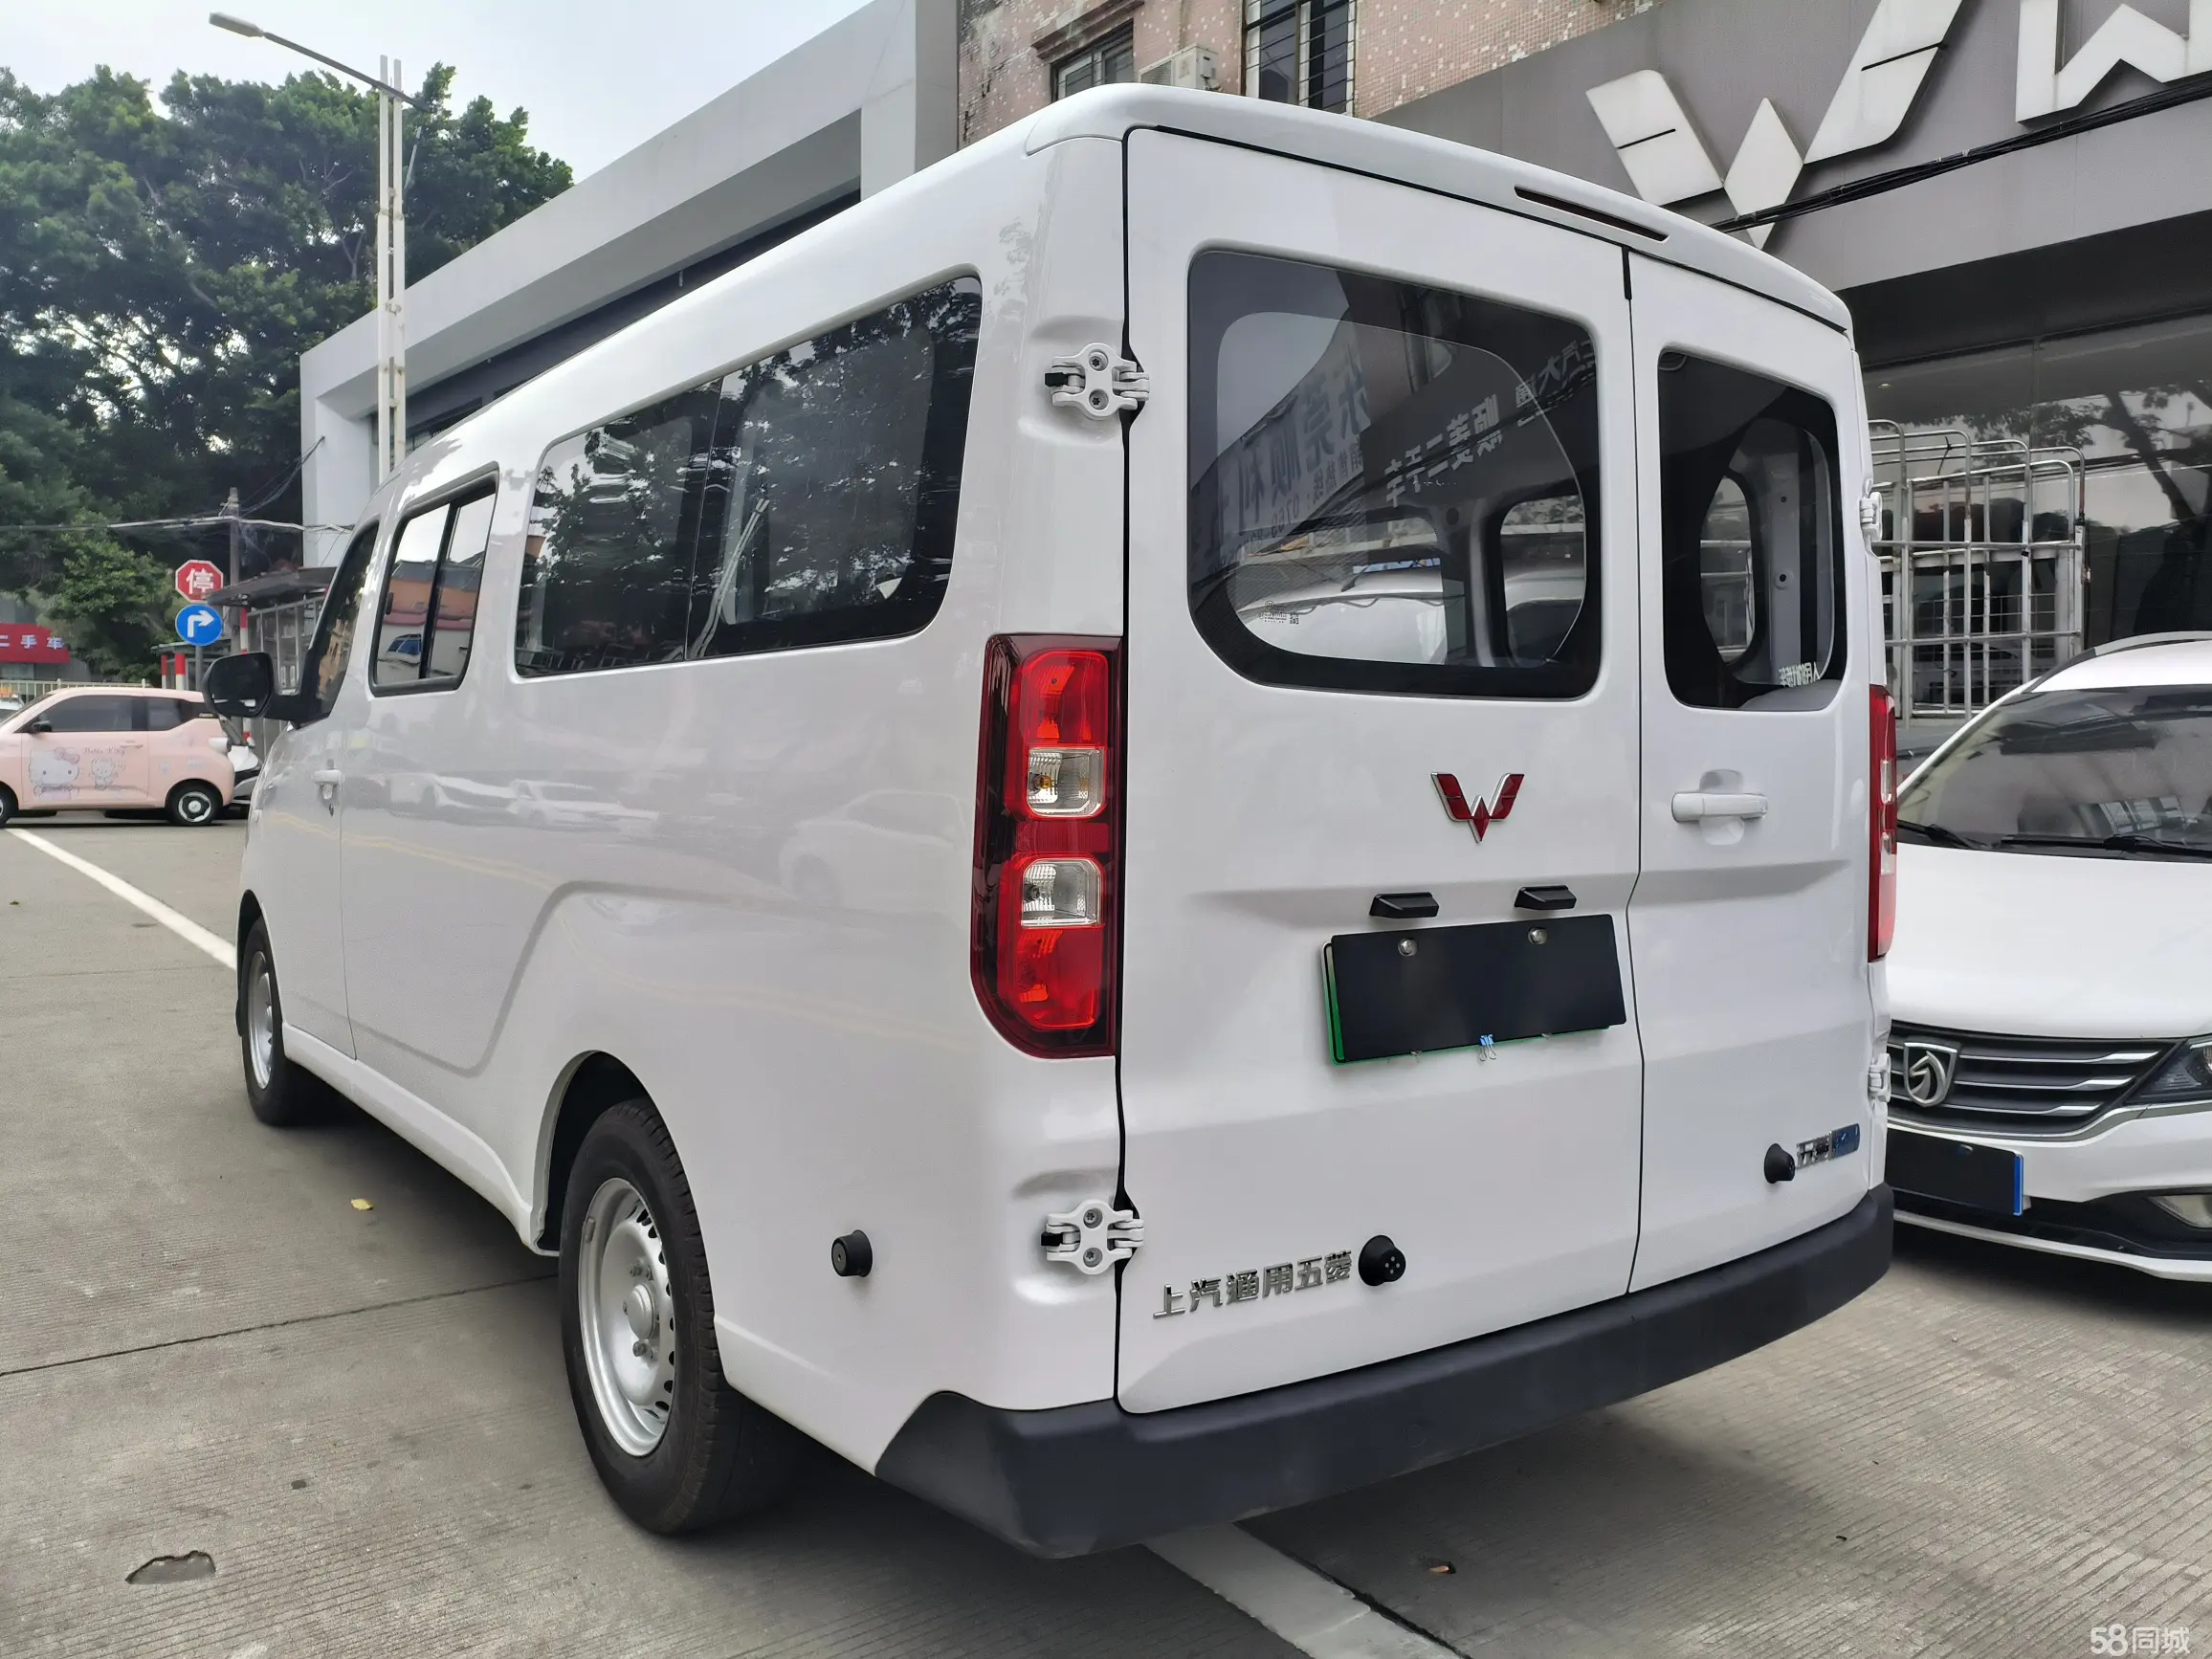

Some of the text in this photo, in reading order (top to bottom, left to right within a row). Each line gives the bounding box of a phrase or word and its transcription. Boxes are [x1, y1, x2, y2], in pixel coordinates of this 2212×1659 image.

[186, 567, 213, 599] 停
[0, 633, 65, 650] 二手车
[1152, 1250, 1352, 1319] 上汽通用五菱
